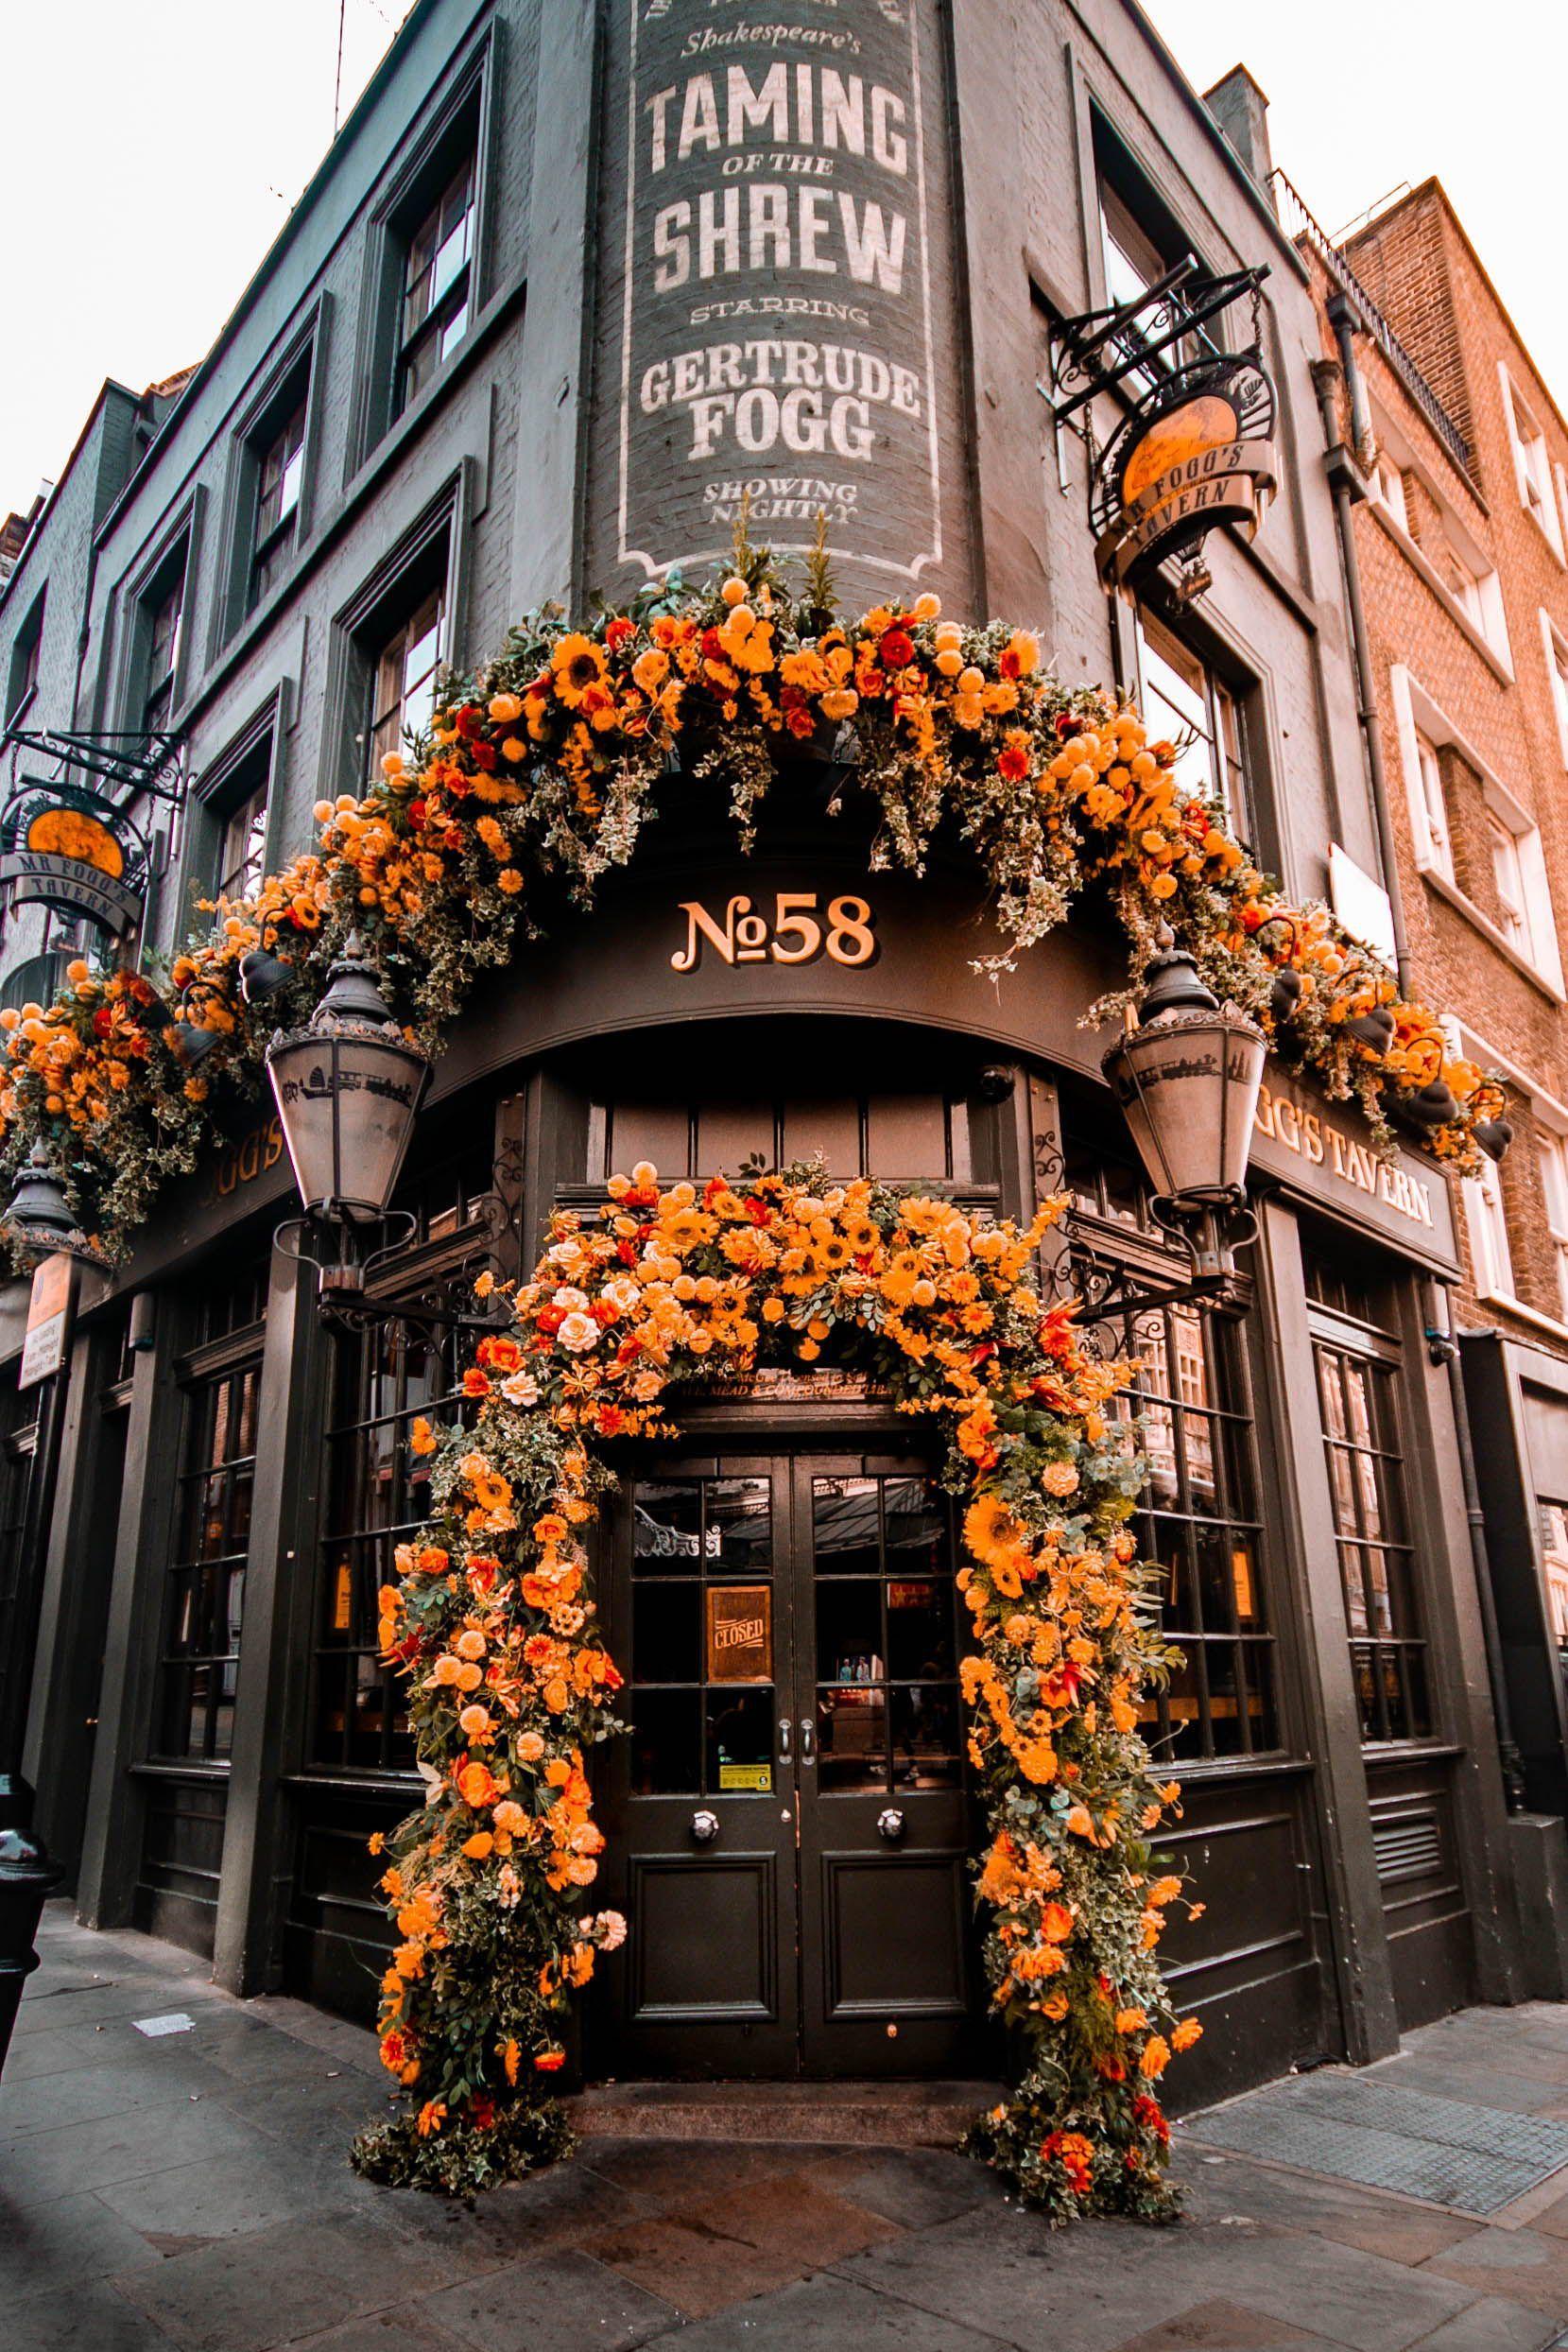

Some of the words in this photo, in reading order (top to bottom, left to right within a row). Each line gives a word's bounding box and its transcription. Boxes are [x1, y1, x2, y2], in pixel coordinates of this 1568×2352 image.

[681, 21, 861, 59] Shakespeare's
[644, 62, 908, 175] TAMING
[722, 154, 761, 177] OF
[769, 153, 835, 177] THE
[654, 184, 907, 295] SHREW
[690, 297, 870, 326] STARRING
[640, 340, 921, 418] GERTRUDE
[687, 388, 876, 462] FOGG
[703, 477, 858, 503] SHOWING
[709, 498, 858, 525] NIGHTLY
[1132, 479, 1230, 545] TAVERN
[19, 856, 52, 873] MR
[31, 877, 114, 915] TAVERN
[1325, 1125, 1434, 1229] TAVERN
[711, 1385, 749, 1395] MEAD
[715, 1618, 764, 1650] CLOSED
